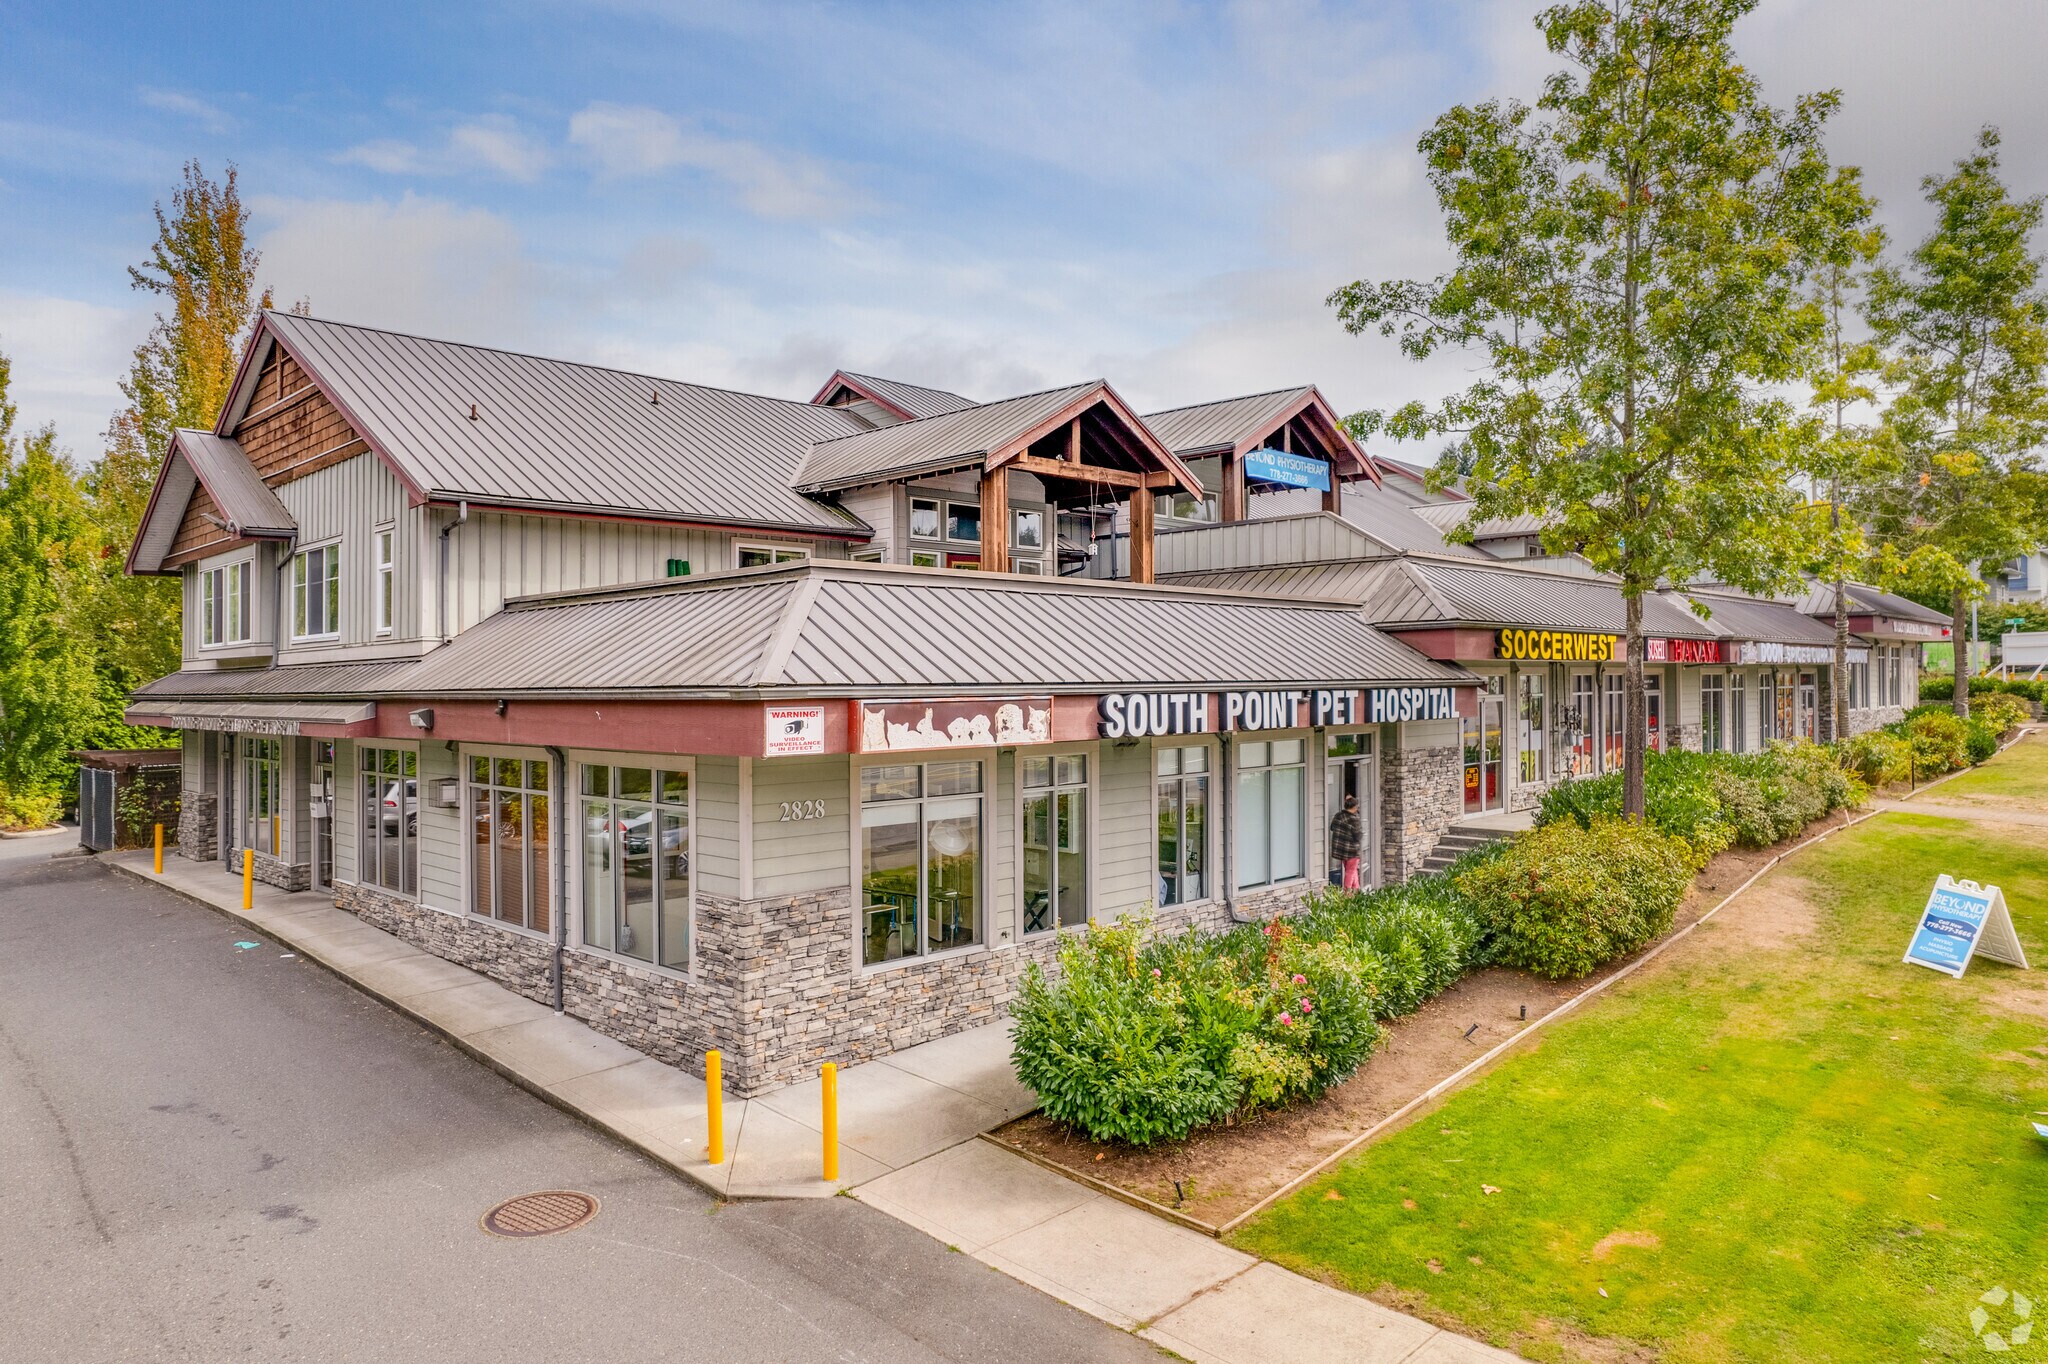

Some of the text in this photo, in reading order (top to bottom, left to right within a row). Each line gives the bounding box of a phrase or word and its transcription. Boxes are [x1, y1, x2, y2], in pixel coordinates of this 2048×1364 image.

[1277, 456, 1327, 476] PHYSIOTHERAPY
[1500, 629, 1616, 660] SOCCERWEST
[1648, 640, 1665, 659] SUSHI
[771, 711, 819, 719] WARNING!
[1102, 687, 1460, 739] SOUTH POINT PET HOSPITAL
[779, 799, 825, 822] 2828
[1931, 903, 1983, 920] PHYSIOTHERAPY
[1934, 893, 1986, 915] BEYOND
